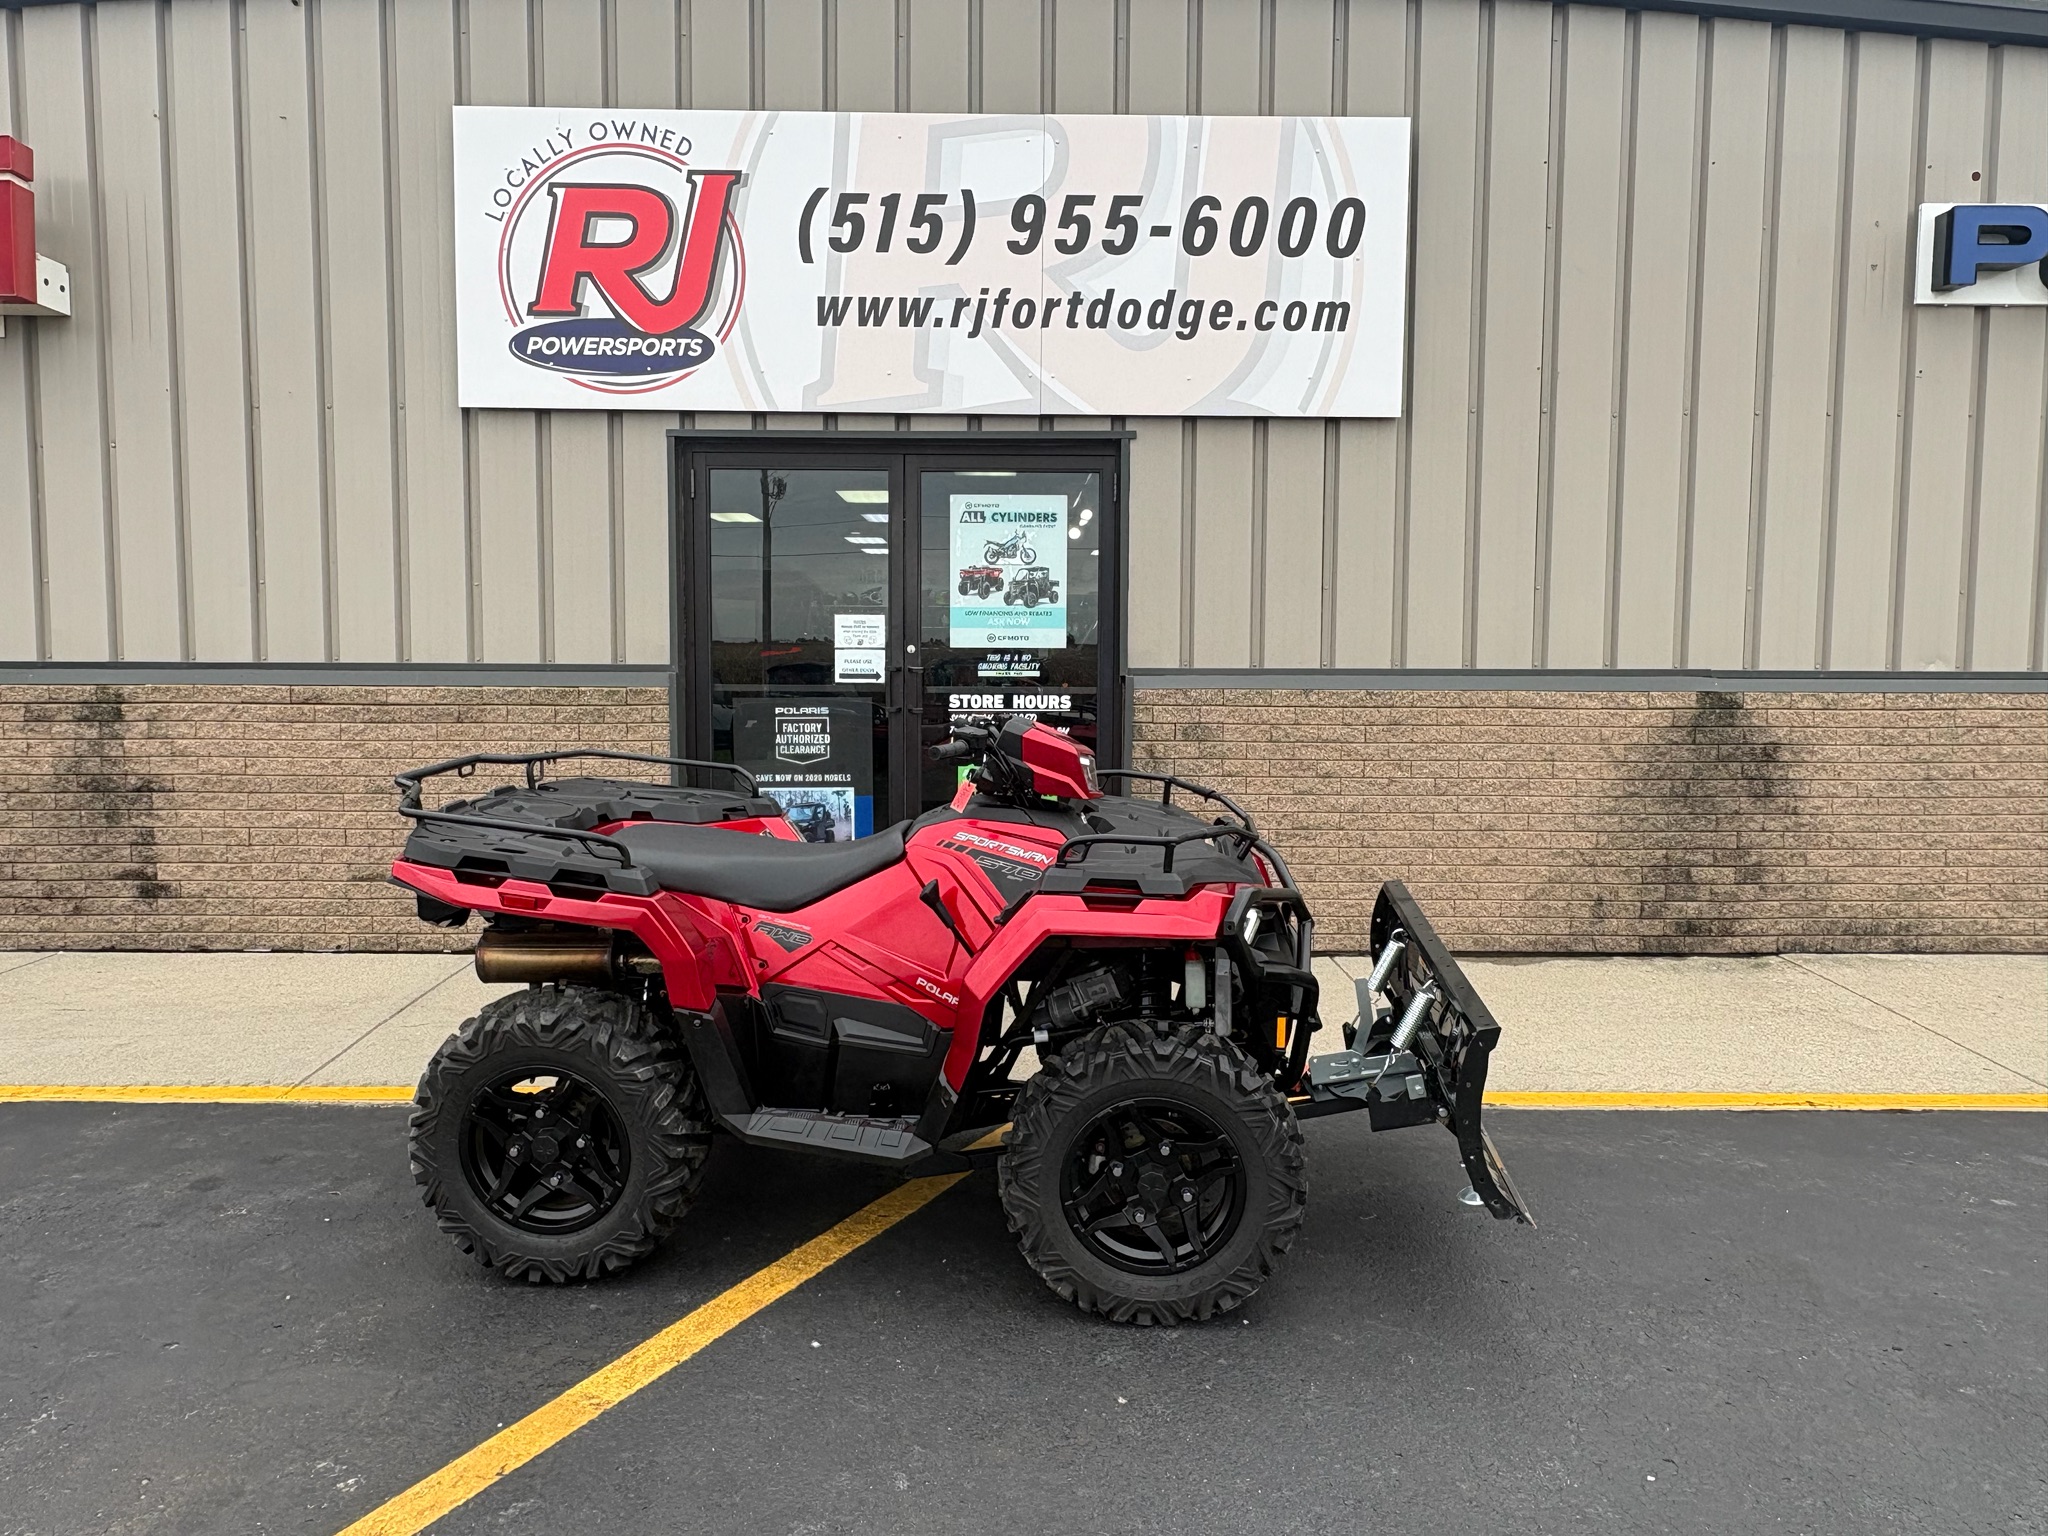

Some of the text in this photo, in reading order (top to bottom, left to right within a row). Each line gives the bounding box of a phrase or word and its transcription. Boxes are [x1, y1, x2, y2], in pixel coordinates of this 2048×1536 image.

[485, 120, 692, 222] LOCALLY OWNED
[799, 187, 1366, 265] (515) 955-6000
[527, 169, 745, 335] RJ
[816, 287, 1351, 341] www.rjfortdodge.com
[526, 336, 703, 357] POWERSPORTS
[961, 511, 1058, 523] ALL CYLINDERS
[1006, 616, 1030, 626] NOW
[949, 694, 1072, 709] STORE HOURS
[775, 706, 829, 715] POLARIS
[782, 723, 822, 733] FACTORY
[775, 734, 831, 744] AUTHORIZED
[779, 745, 826, 754] CLEARANCE
[755, 774, 774, 782] SAVE
[775, 774, 792, 782] NOW
[793, 774, 804, 782] ON
[824, 774, 852, 782] MODELS
[953, 831, 1054, 865] SPORTSMAN
[975, 855, 1043, 881] 570
